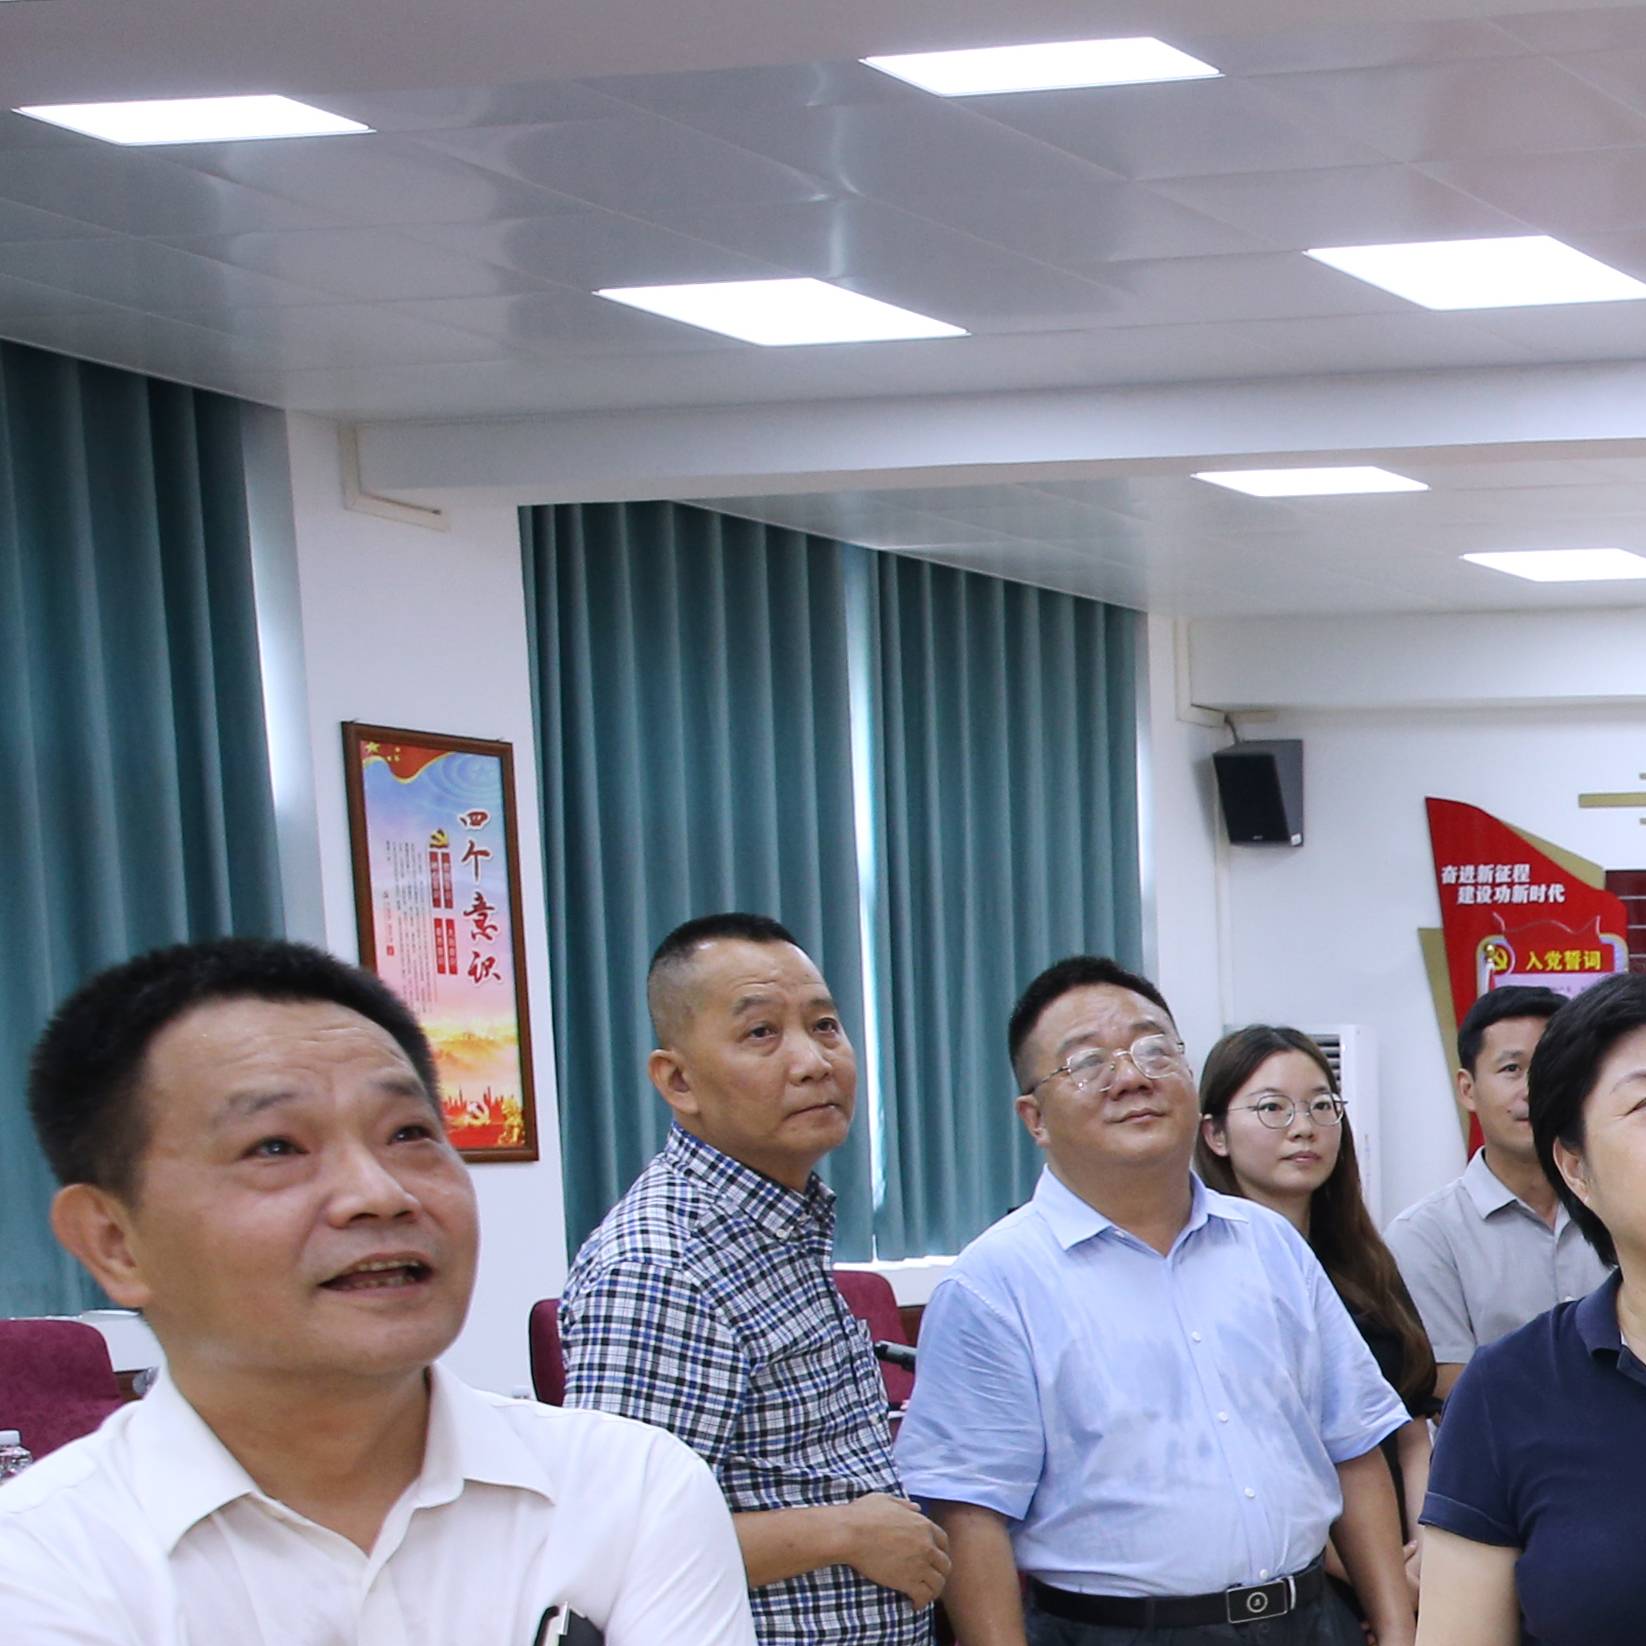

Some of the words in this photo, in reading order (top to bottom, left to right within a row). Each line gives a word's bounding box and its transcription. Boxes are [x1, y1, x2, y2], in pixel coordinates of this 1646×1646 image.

[1441, 863, 1531, 885] 奋进新征程
[459, 810, 502, 984] 四个意识
[1525, 950, 1601, 972] 入党誓词
